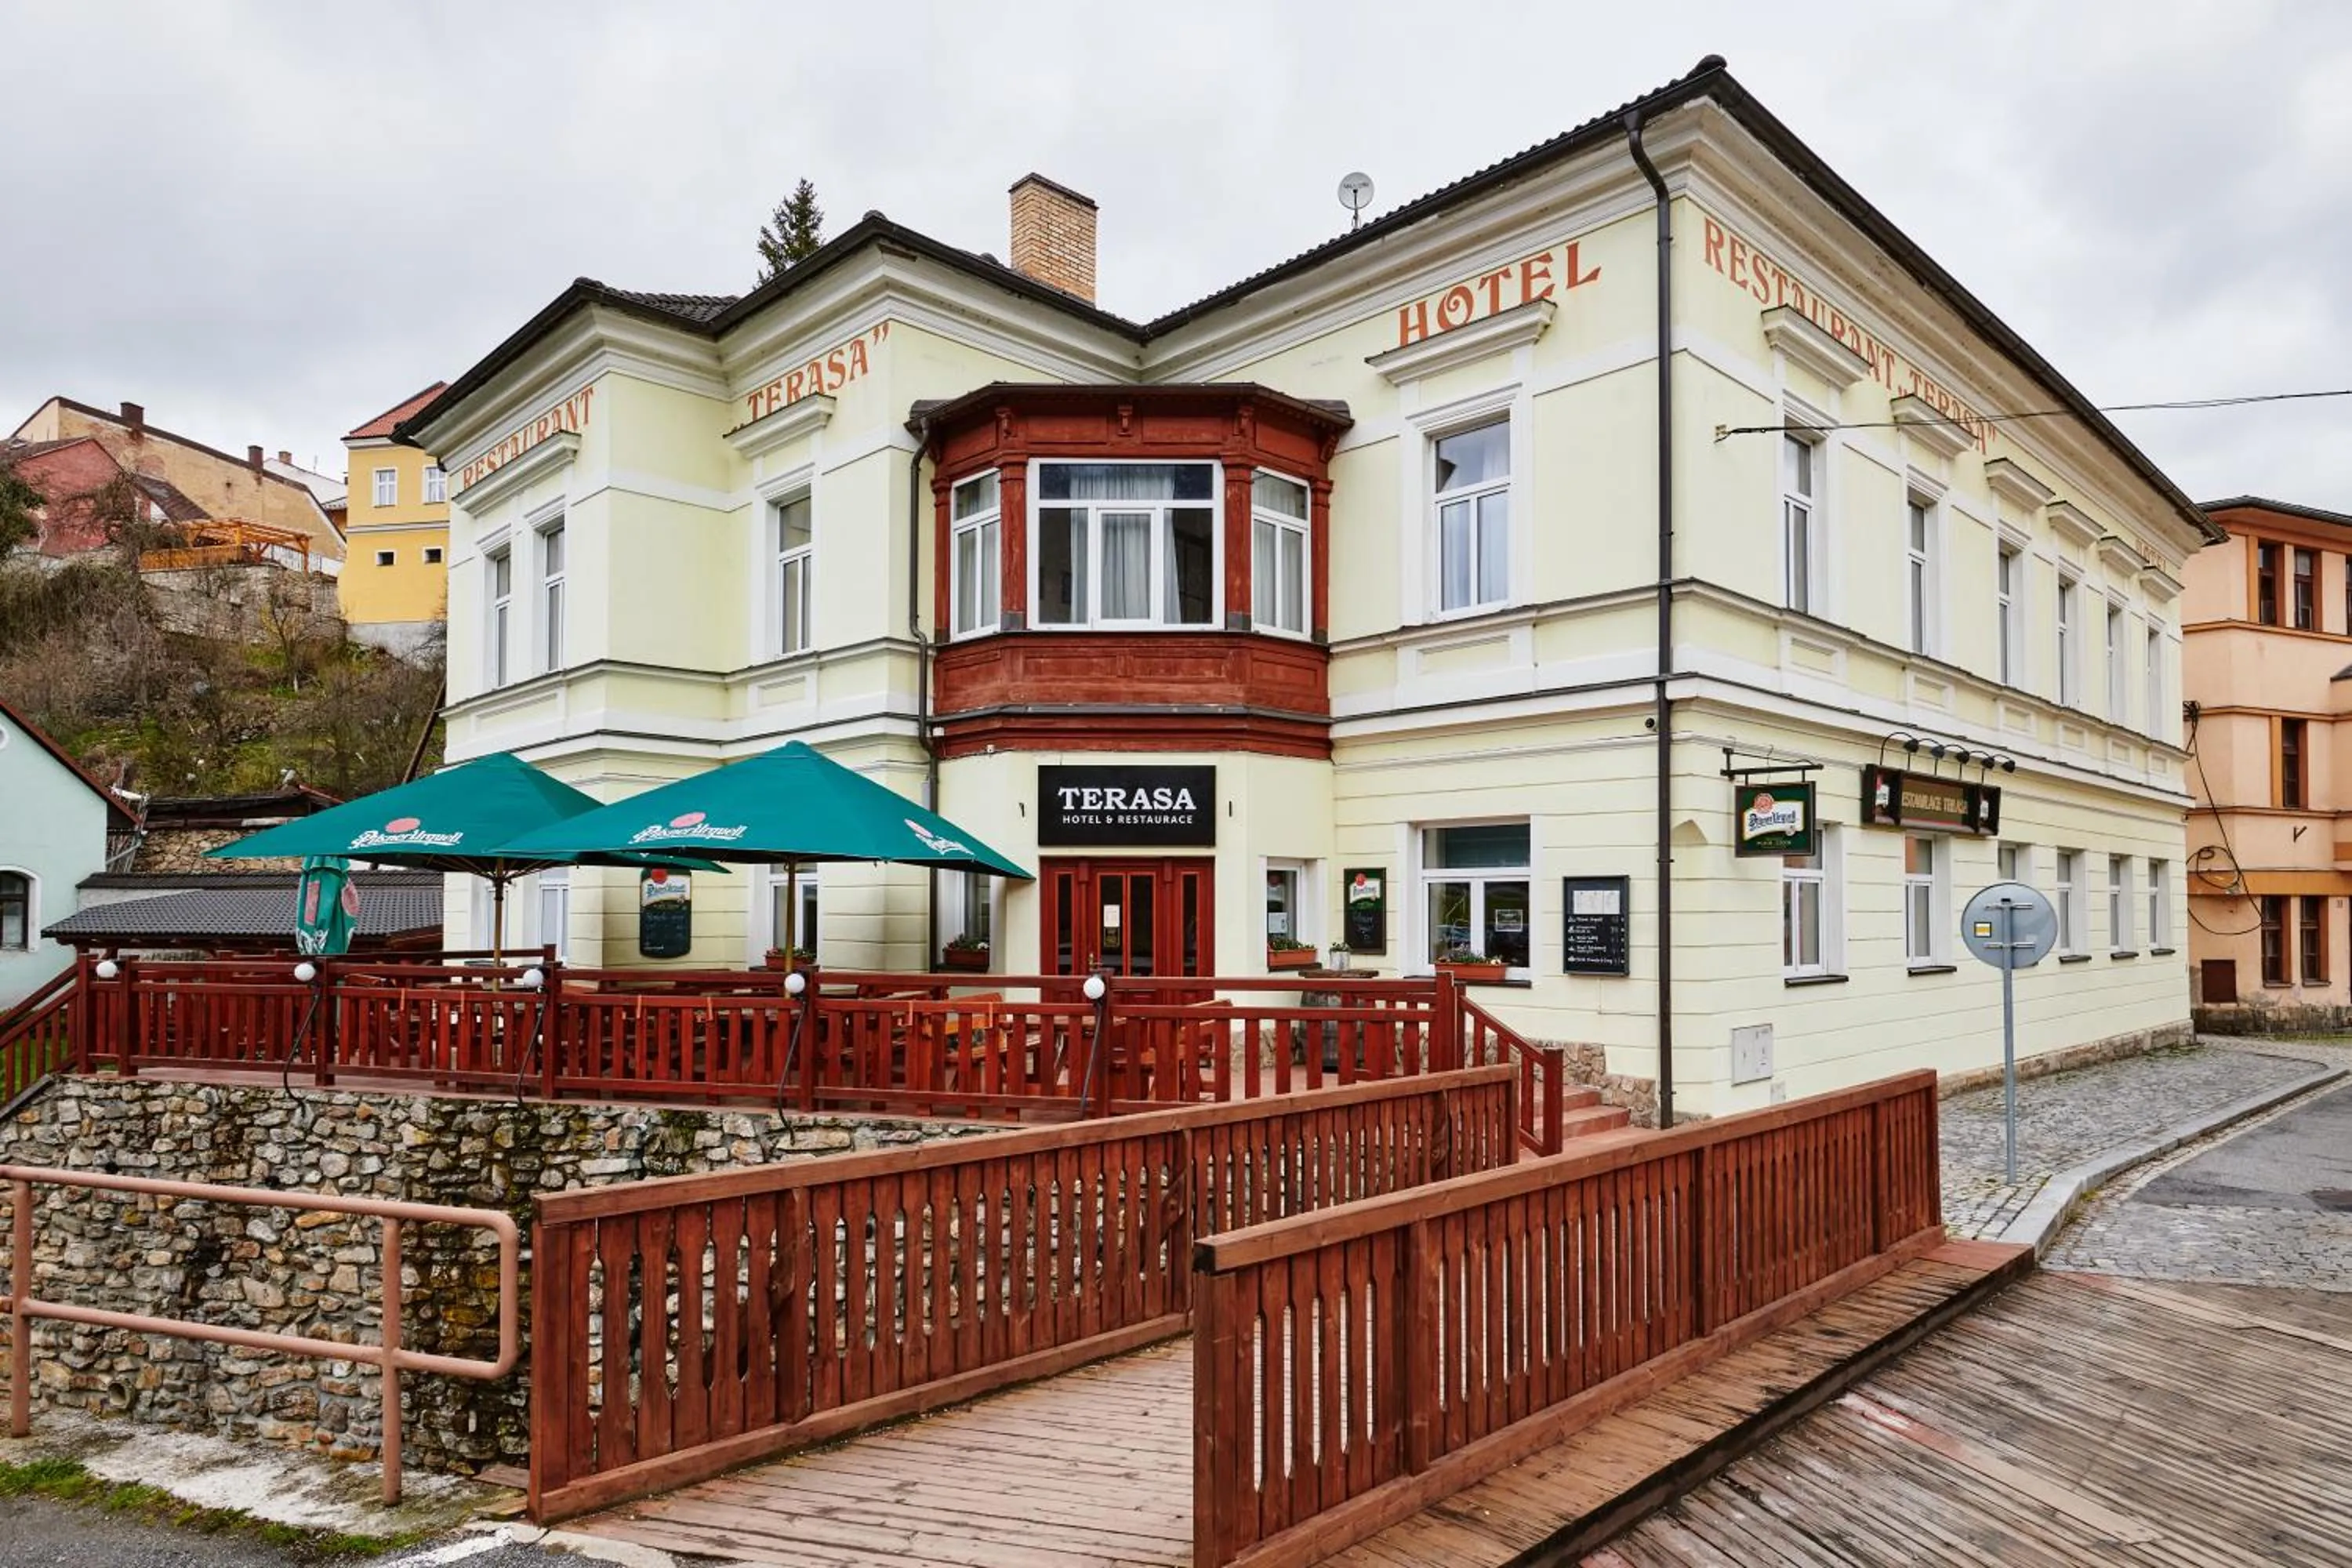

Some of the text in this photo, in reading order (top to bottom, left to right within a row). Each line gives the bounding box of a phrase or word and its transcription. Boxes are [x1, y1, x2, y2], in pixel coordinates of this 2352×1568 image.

[1399, 241, 1602, 347] HOTEL
[1704, 217, 1895, 390] RESTAURANT
[463, 387, 594, 490] RESTAURANT
[1058, 787, 1196, 811] TERASA
[1062, 815, 1192, 824] HOTEL & RESTAURACE
